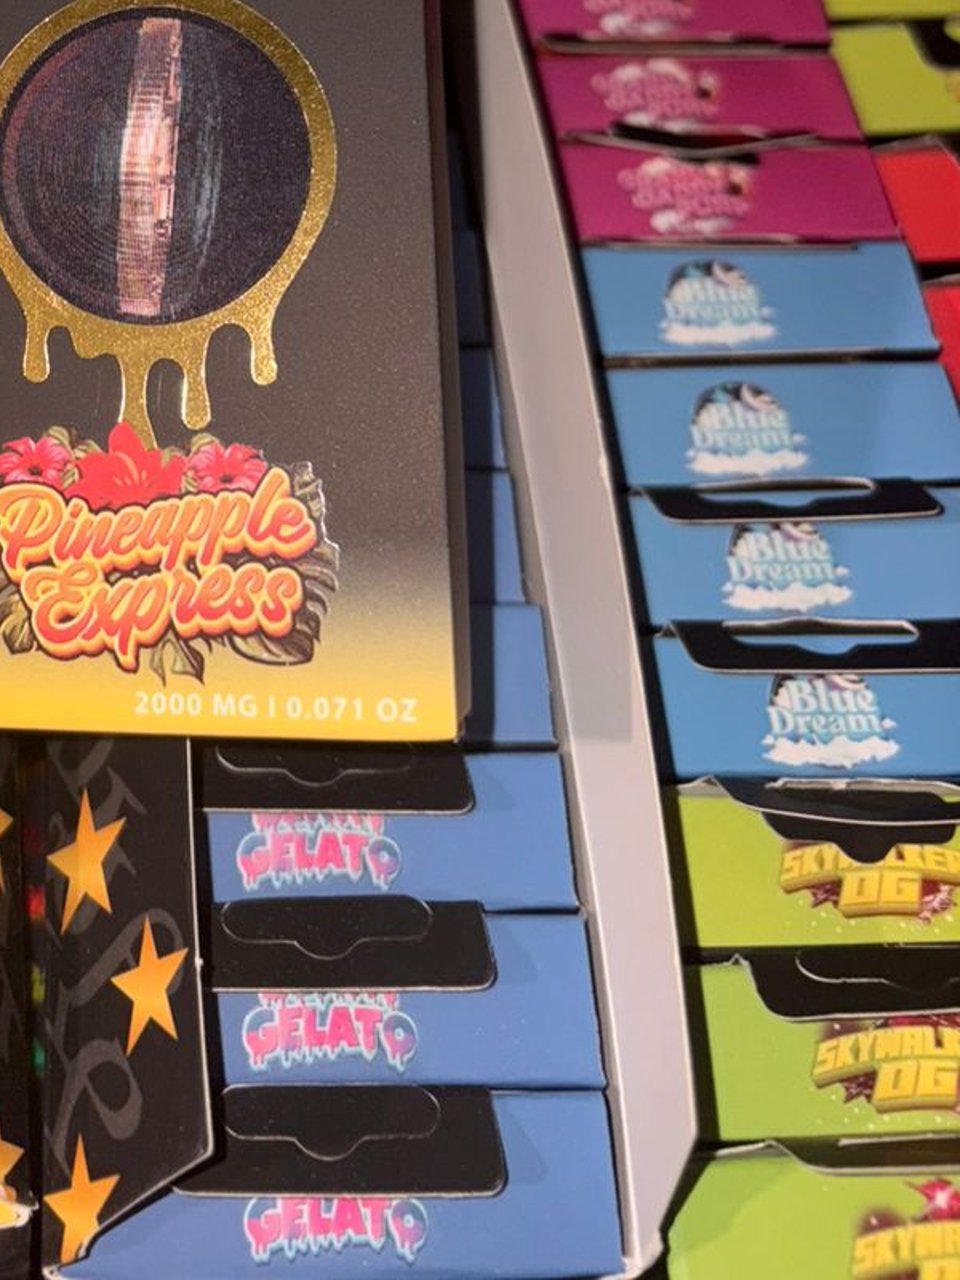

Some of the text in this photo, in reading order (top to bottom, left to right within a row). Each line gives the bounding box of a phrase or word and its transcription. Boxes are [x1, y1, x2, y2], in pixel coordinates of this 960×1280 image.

[727, 556, 835, 583] Dream
[749, 529, 831, 562] Blue
[21, 561, 304, 674] Express
[133, 691, 203, 717] 2000
[212, 693, 257, 719] MG
[286, 695, 365, 722] 0.071
[375, 697, 419, 724] OZ
[789, 677, 878, 713] Blue
[767, 706, 884, 737] Dream
[237, 829, 401, 891] GELATO
[840, 869, 922, 918] OG
[242, 1002, 418, 1072] GELATO
[871, 1058, 960, 1114] OG
[243, 1197, 428, 1266] GELATO
